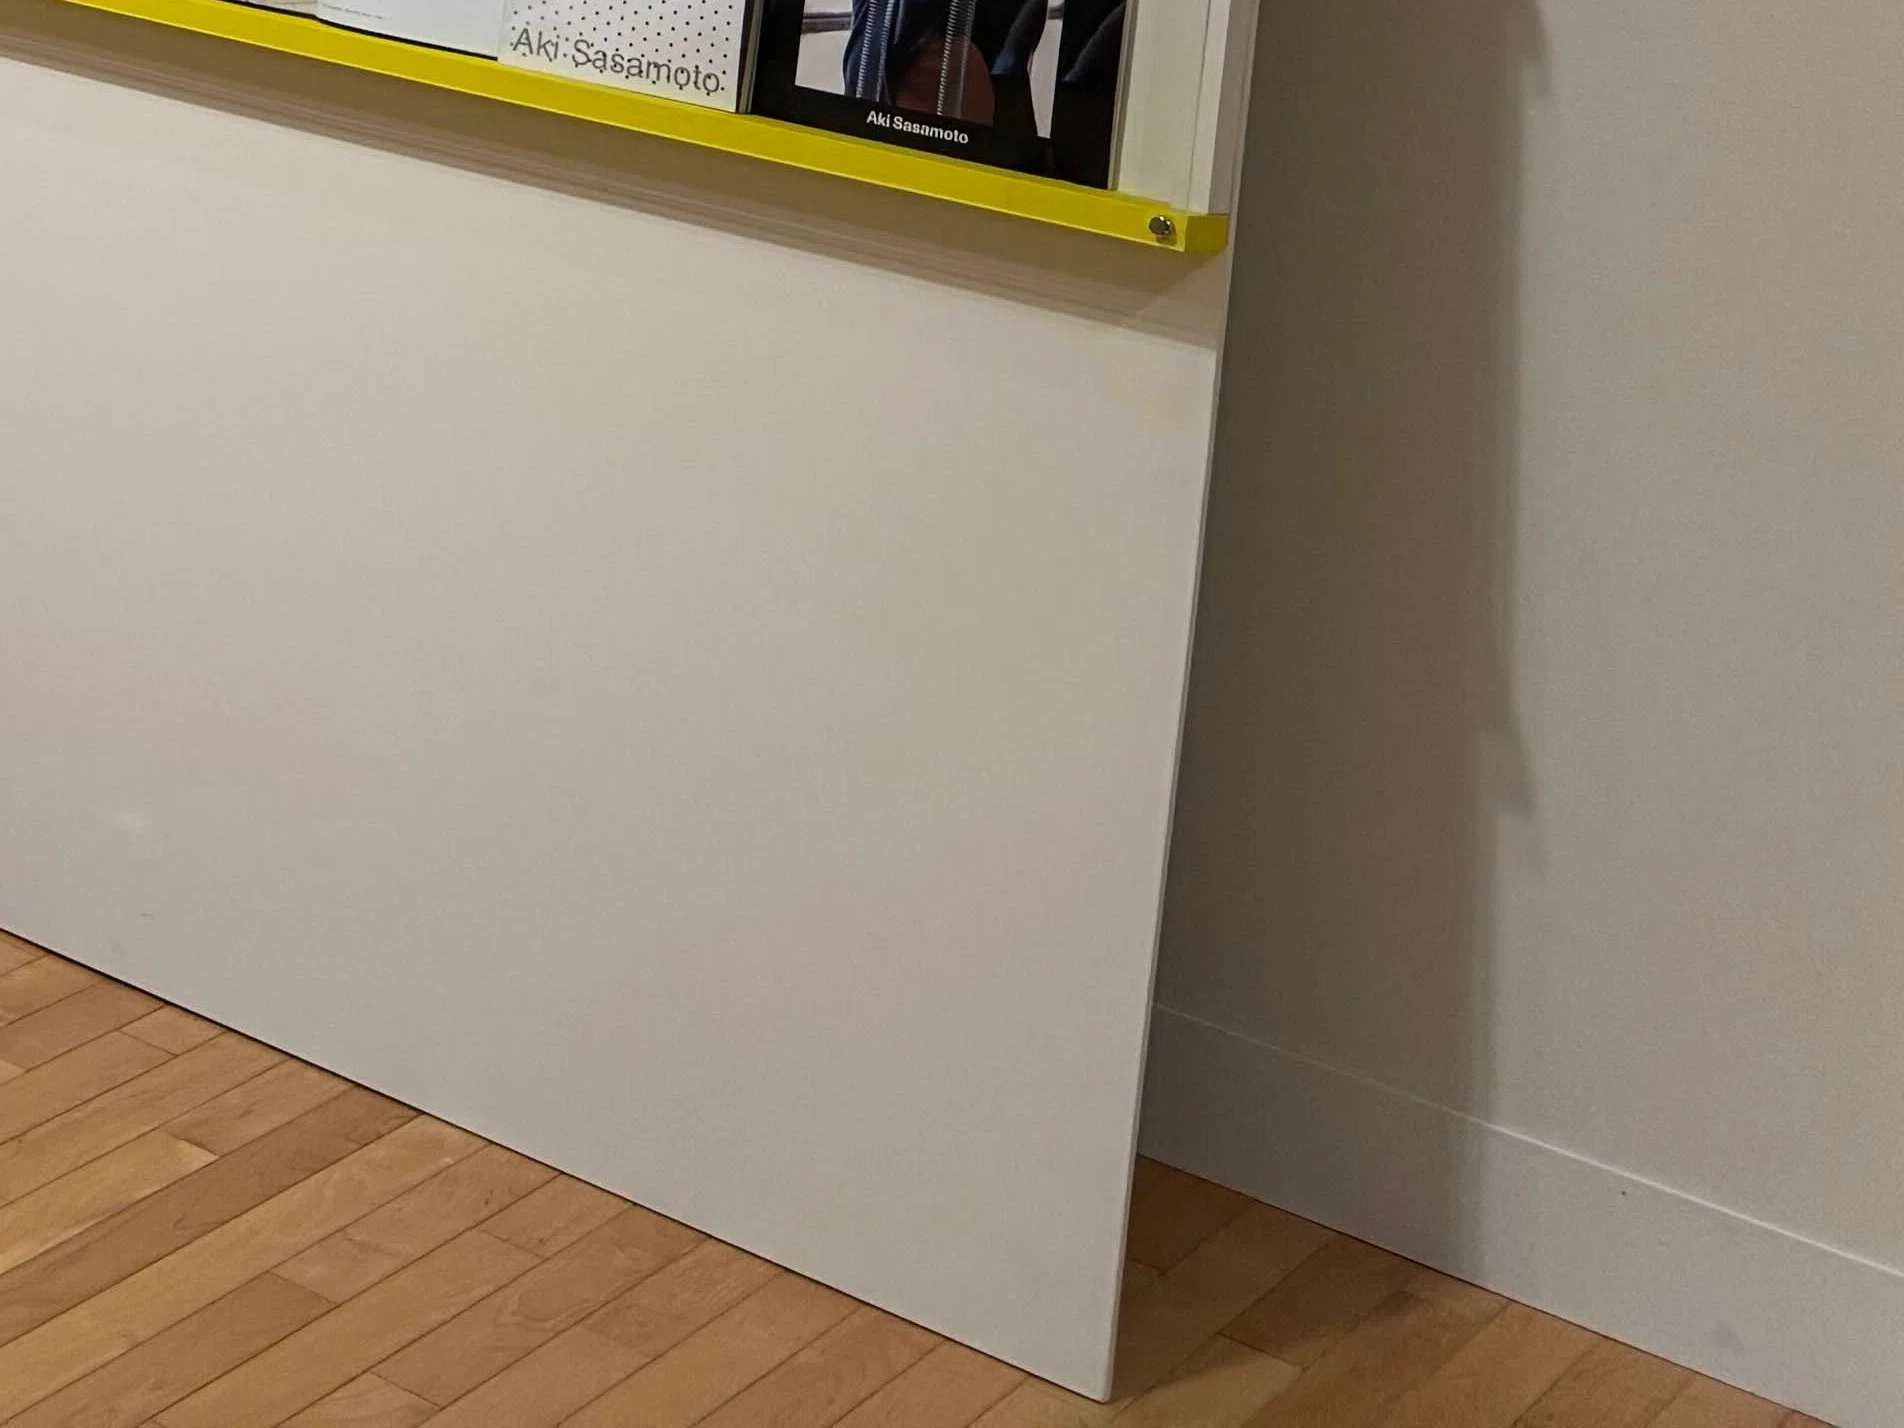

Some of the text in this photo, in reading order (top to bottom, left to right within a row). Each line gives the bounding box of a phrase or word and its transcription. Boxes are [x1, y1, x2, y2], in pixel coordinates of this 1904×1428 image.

[512, 27, 721, 94] Aki Sasamoto
[866, 110, 969, 144] Aki Sasamoto
